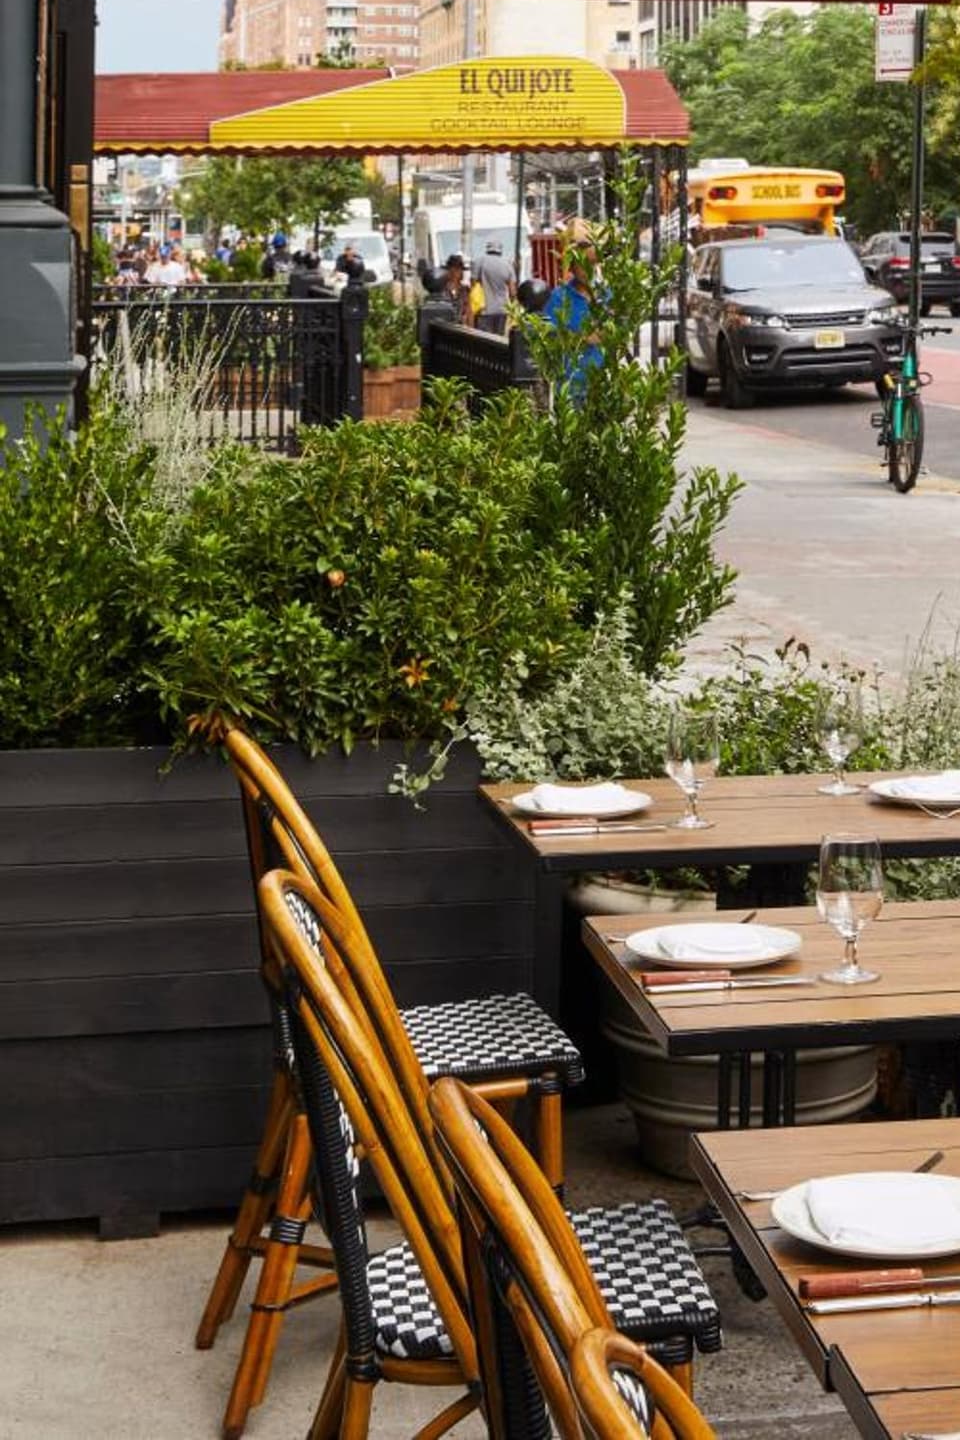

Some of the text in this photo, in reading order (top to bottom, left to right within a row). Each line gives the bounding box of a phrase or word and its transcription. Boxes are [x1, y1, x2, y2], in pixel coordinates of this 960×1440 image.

[460, 68, 575, 99] EL QUIJOTE
[458, 100, 568, 112] RESTAURANT
[431, 117, 586, 129] COCKTAIL LOUNGE
[752, 184, 801, 200] SCHOOL BUS
